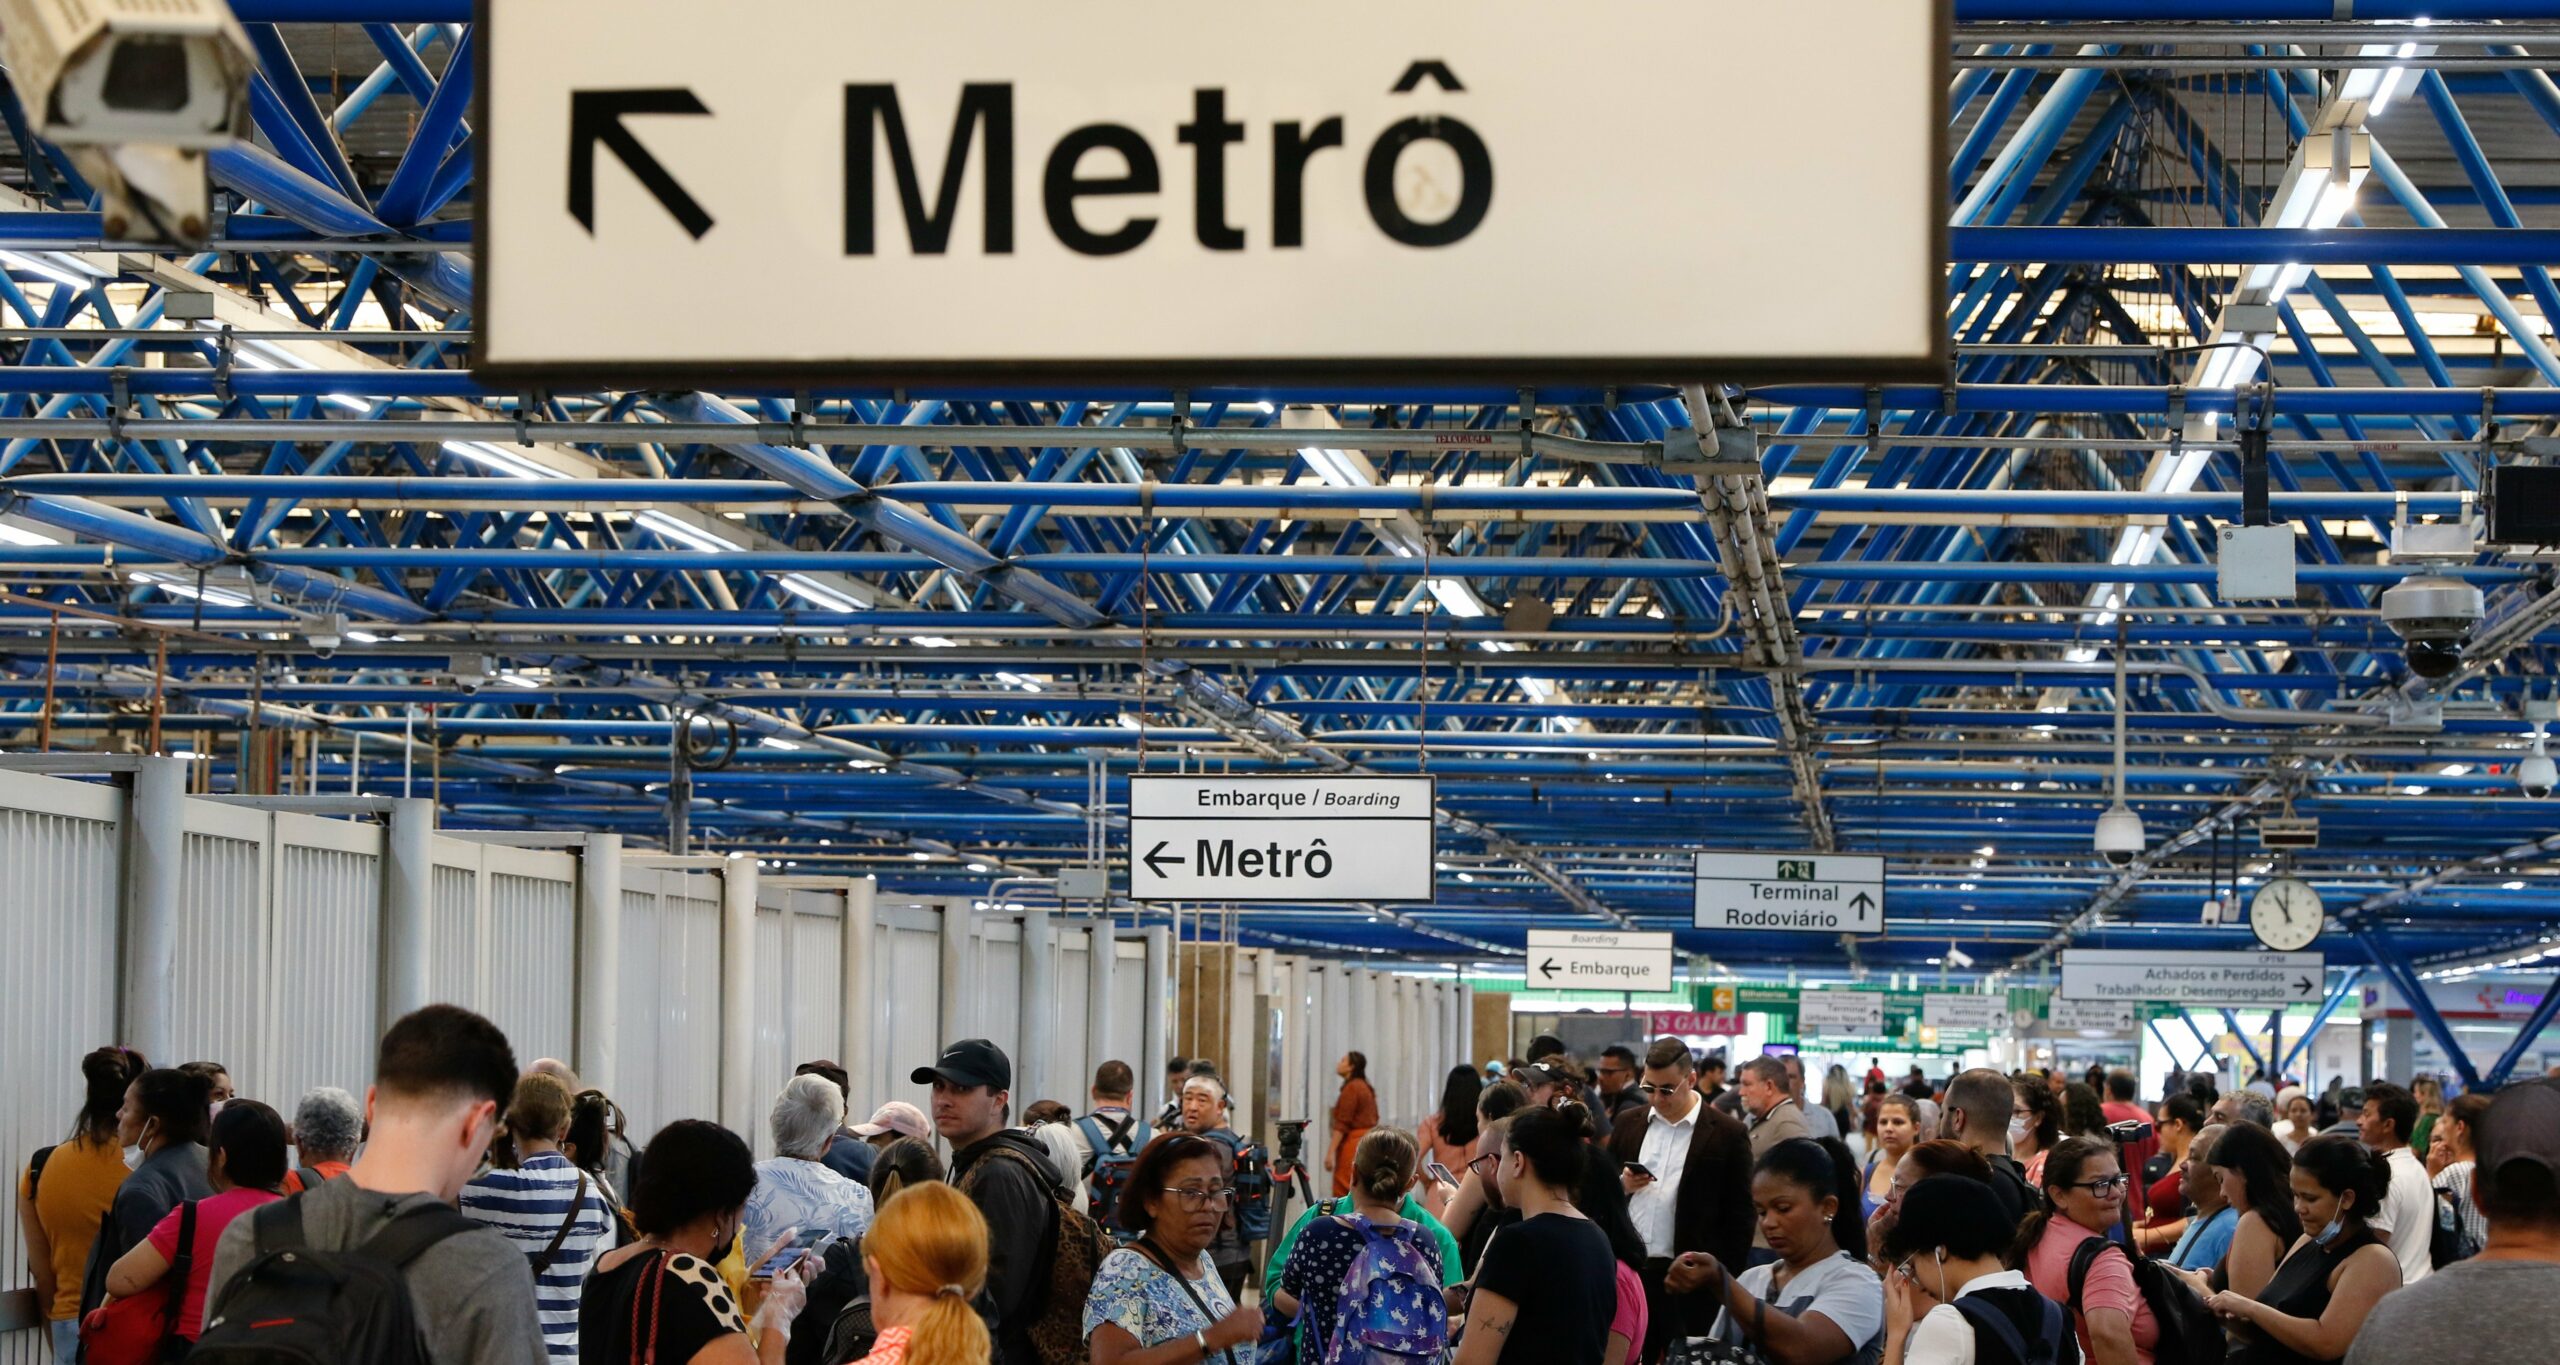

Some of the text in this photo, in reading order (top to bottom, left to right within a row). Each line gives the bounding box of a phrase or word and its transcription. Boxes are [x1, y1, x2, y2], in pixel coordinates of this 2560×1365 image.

[843, 59, 1494, 257] Metrô
[1198, 788, 1401, 810] Embarque / Boarding
[1197, 839, 1333, 879] Metrô
[1750, 883, 1839, 901] Terminal
[1726, 908, 1838, 928] Rodoviário
[1571, 934, 1619, 946] Boarding
[1570, 961, 1650, 979] Embarque
[2145, 968, 2286, 983] Achados e Perdidos
[2095, 984, 2286, 1000] Trabalhador Desempregado
